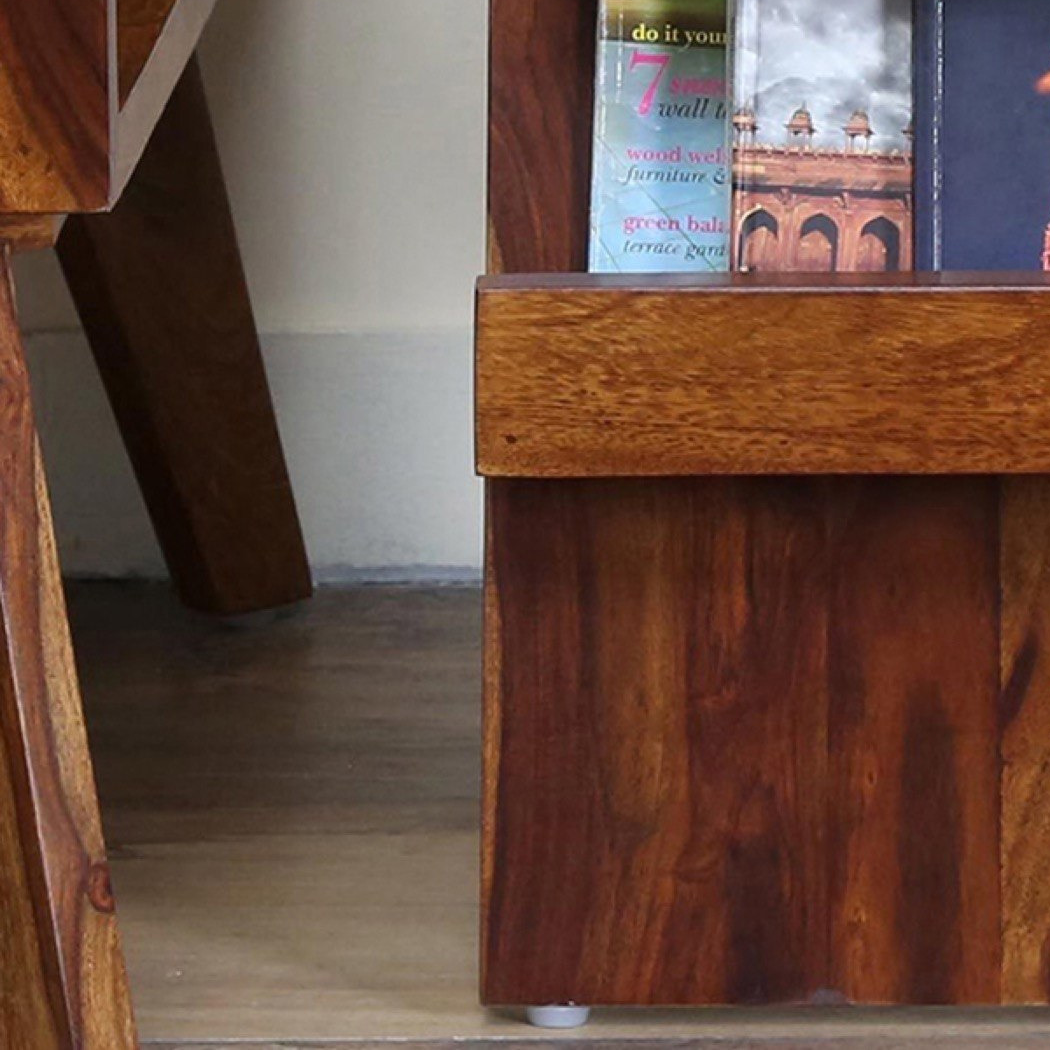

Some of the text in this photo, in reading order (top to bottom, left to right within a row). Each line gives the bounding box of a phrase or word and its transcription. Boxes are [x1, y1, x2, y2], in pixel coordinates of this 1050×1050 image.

[631, 22, 659, 42] do
[664, 23, 679, 43] it
[628, 50, 672, 118] 7
[658, 97, 710, 119] wall
[626, 146, 682, 163] wood
[620, 164, 708, 185] furniture
[623, 216, 680, 236] green
[623, 239, 681, 255] terrace
